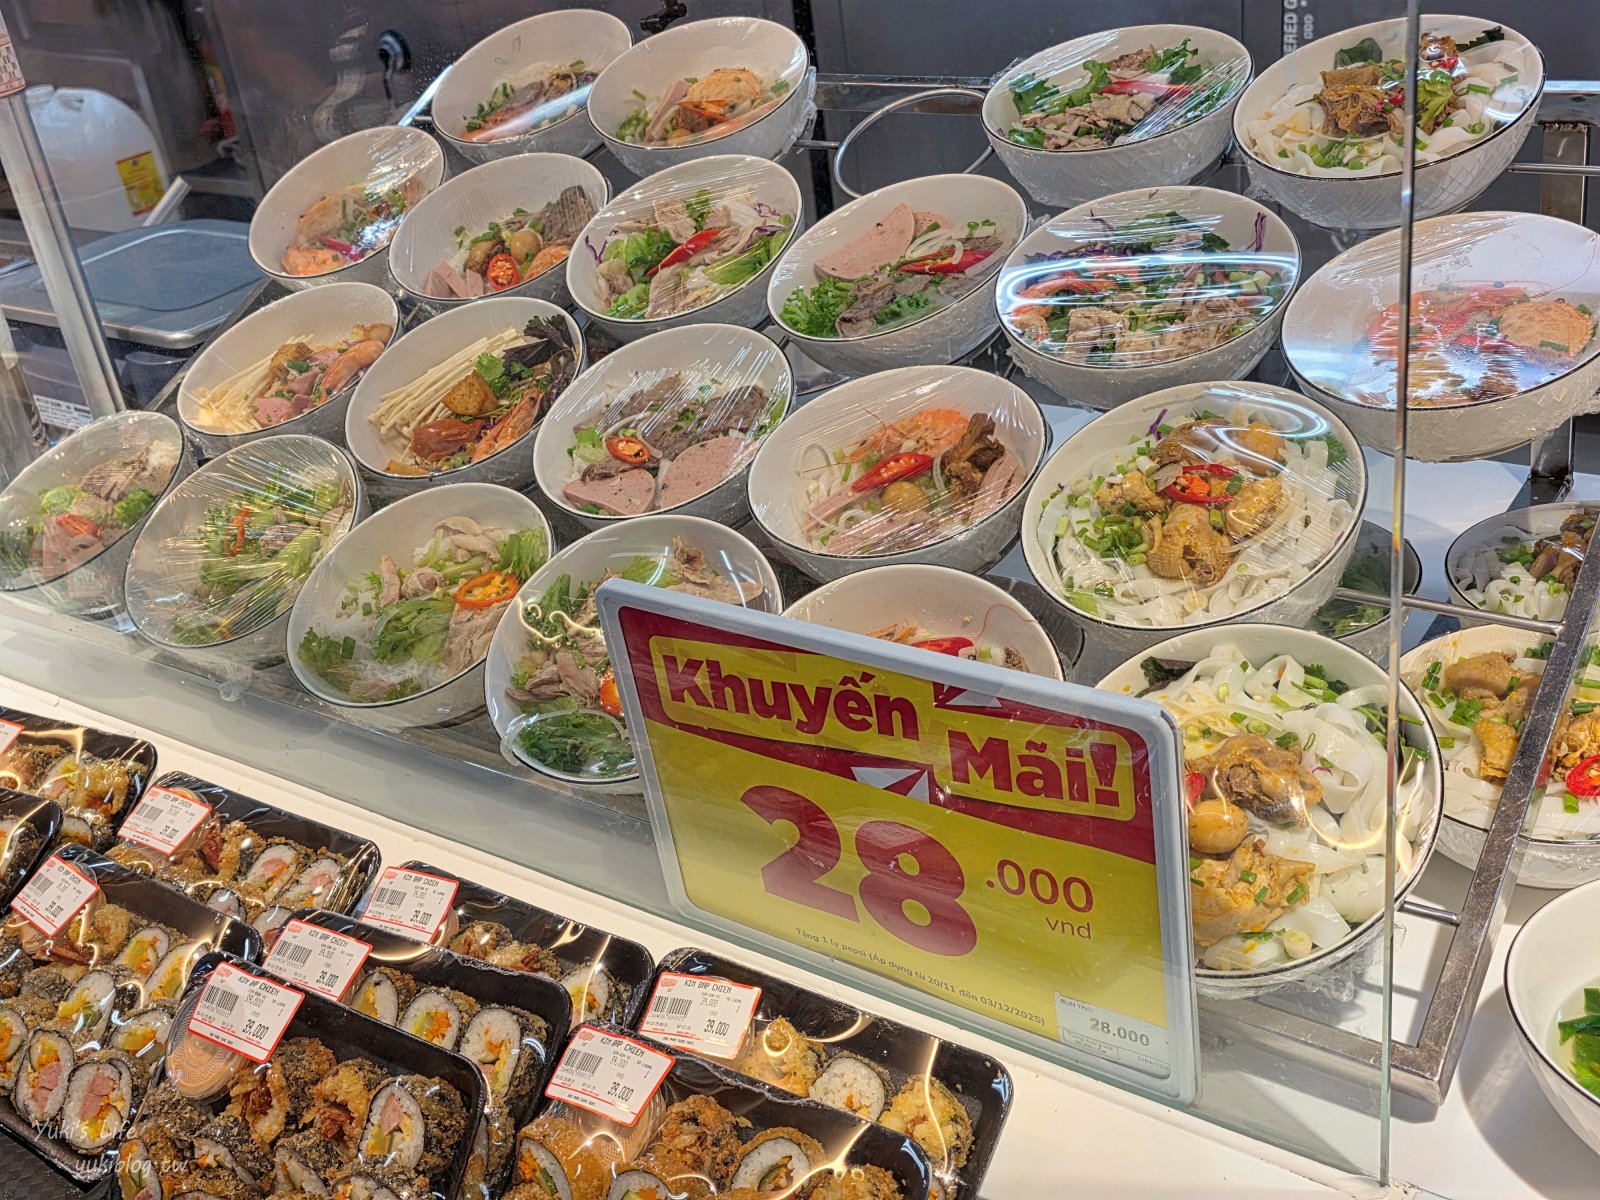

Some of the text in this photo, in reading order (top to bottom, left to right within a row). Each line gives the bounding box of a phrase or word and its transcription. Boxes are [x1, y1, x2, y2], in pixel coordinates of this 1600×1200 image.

[662, 654, 920, 740] Khuyến
[947, 729, 1121, 807] Mãi!
[740, 785, 978, 957] 28
[1045, 916, 1092, 940] vnd
[237, 976, 249, 985] KIM
[842, 943, 867, 958] pepsi
[928, 975, 957, 994] 20/11
[684, 980, 697, 988] KIM
[698, 981, 710, 991] BAP
[703, 1018, 730, 1036] 39.000
[1089, 1018, 1150, 1046] 28.000
[600, 1037, 610, 1045] KIM
[611, 1039, 623, 1048] BAP
[624, 1043, 646, 1058] CHIEN
[607, 1081, 634, 1102] 39.000
